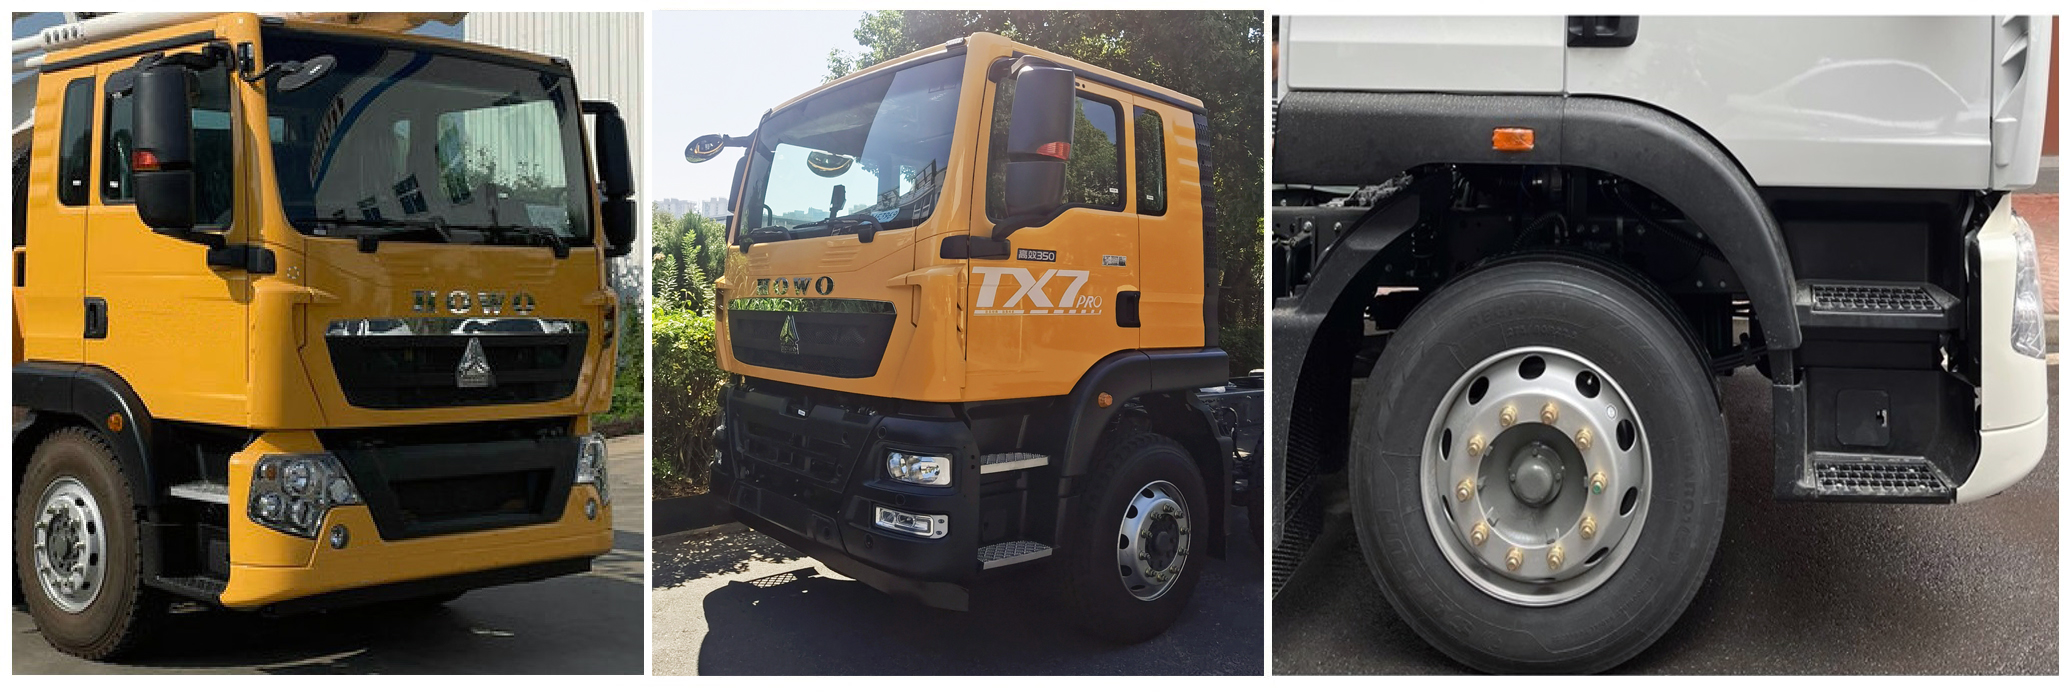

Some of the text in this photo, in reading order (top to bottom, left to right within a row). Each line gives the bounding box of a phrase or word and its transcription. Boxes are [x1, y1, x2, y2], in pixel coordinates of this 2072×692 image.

[1018, 249, 1055, 261] 高效350
[756, 276, 834, 296] HOWO
[972, 266, 1103, 308] TX7 PRO
[412, 290, 536, 315] HOWO
